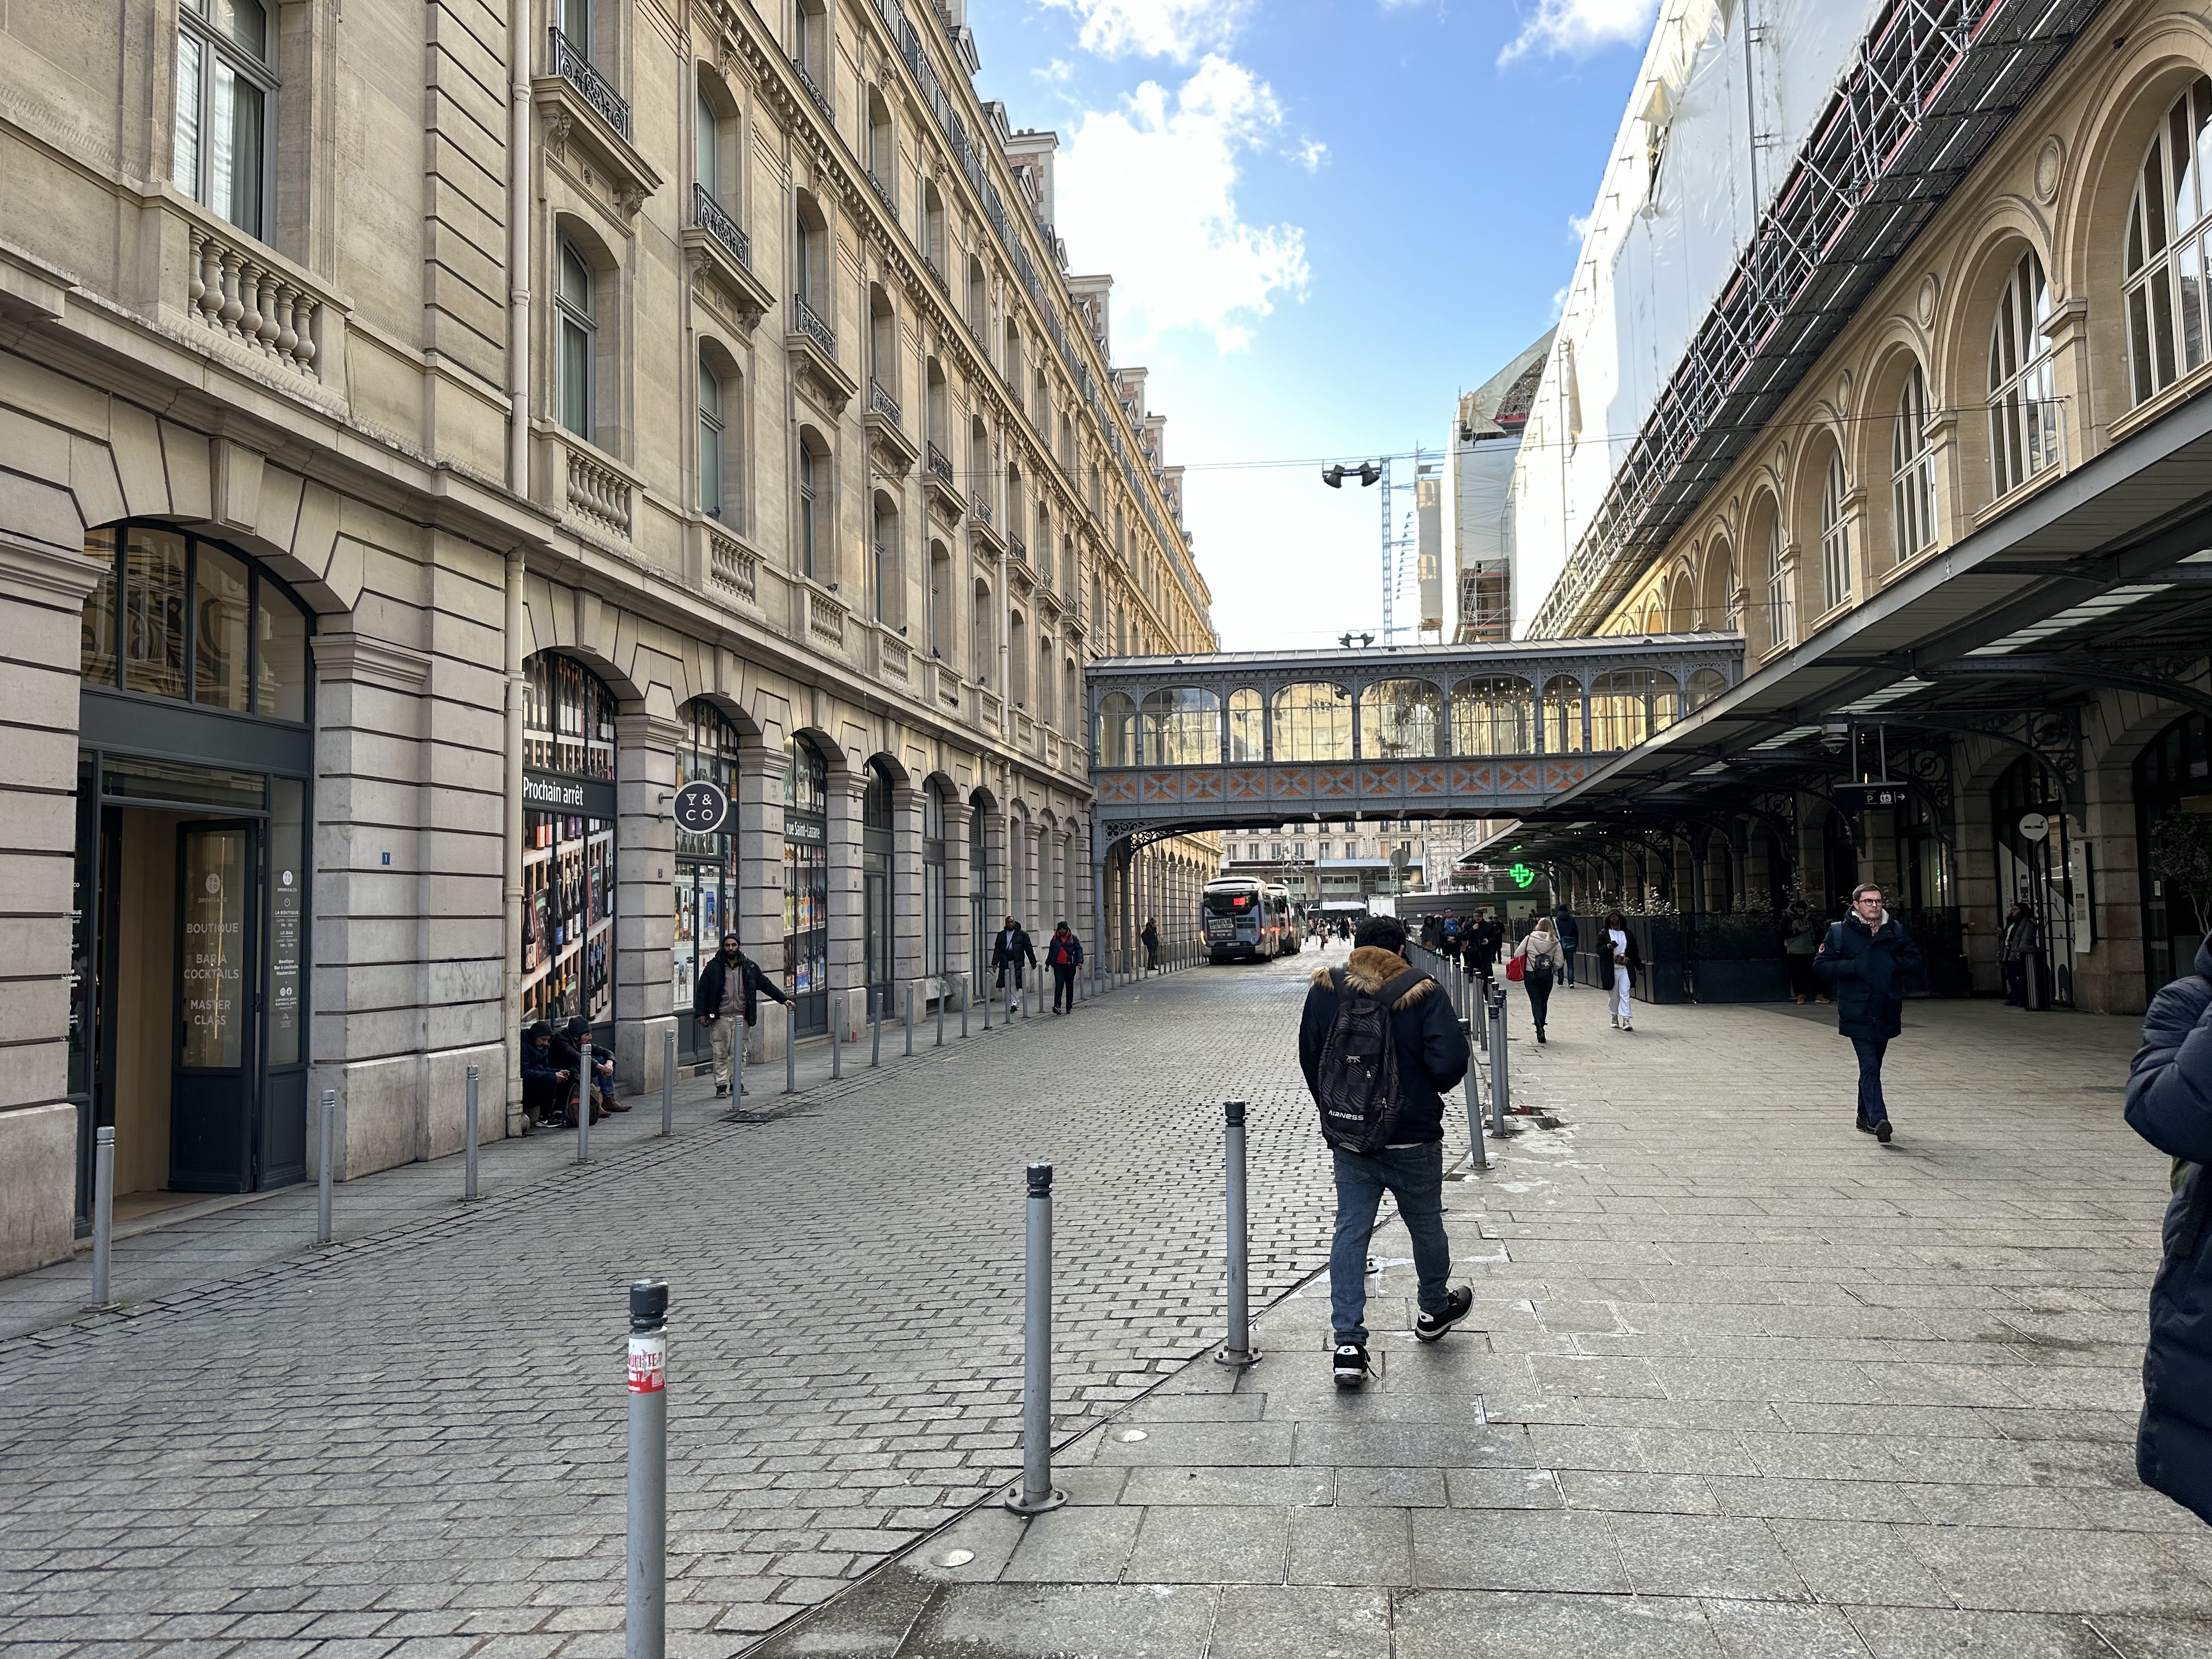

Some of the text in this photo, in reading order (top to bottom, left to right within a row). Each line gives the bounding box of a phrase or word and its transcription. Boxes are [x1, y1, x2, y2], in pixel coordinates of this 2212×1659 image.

[523, 776, 583, 805] Prochain arrêt
[794, 821, 820, 839] Saint-Lazare
[187, 923, 239, 933] BOUTIQUE
[196, 953, 217, 964] BAR
[184, 969, 239, 979] COCKTAILS
[190, 1000, 231, 1009] MASTER
[194, 1015, 227, 1025] CLASS
